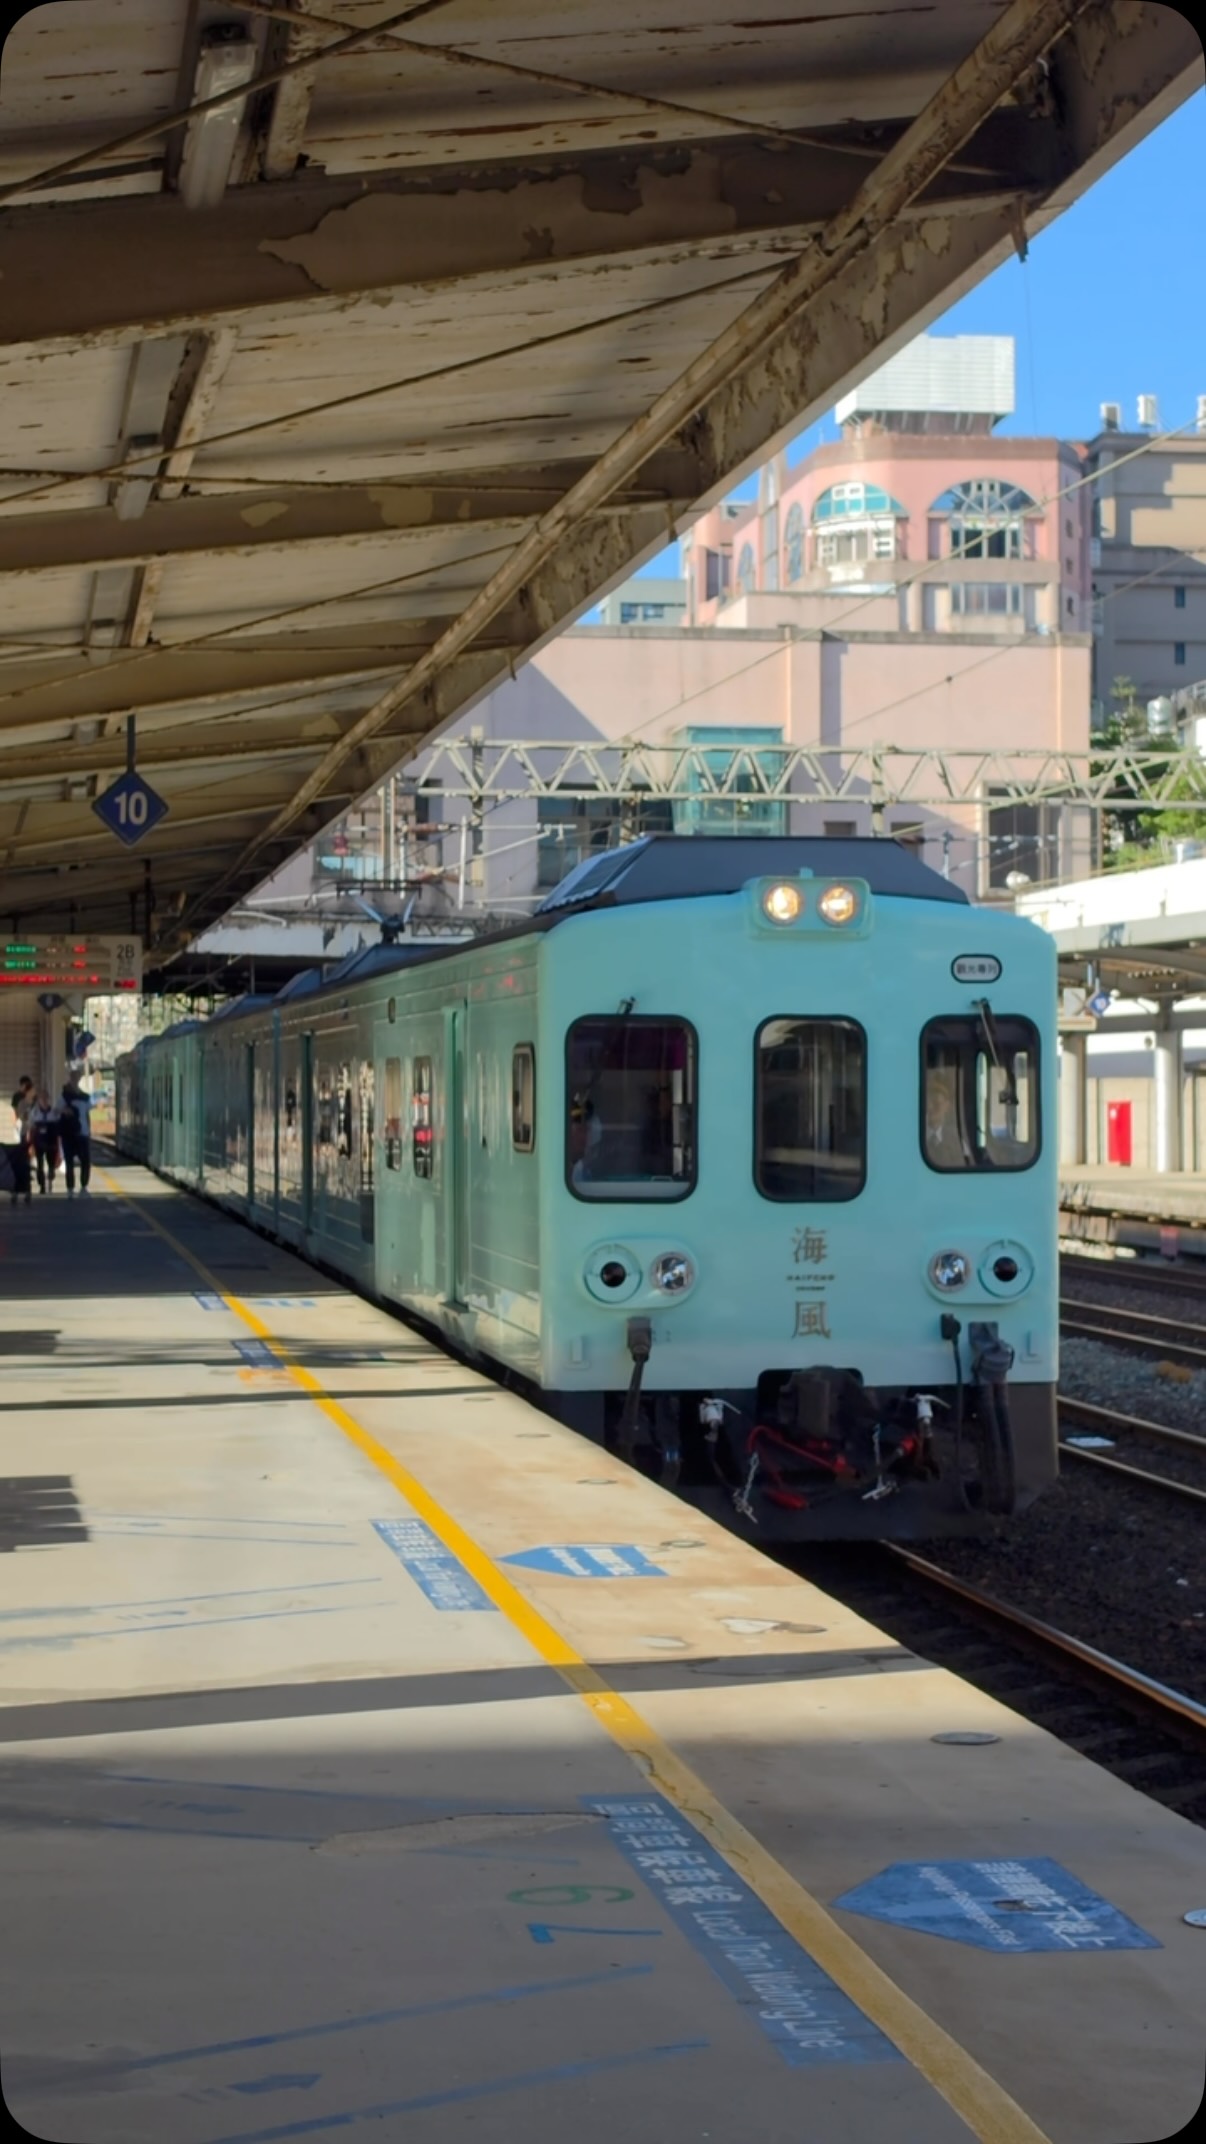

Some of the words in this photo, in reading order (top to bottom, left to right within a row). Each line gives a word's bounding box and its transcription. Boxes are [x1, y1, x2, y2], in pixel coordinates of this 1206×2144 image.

[114, 792, 148, 825] 10
[116, 943, 135, 959] 2B
[792, 1226, 828, 1264] 海
[791, 1301, 831, 1339] 風
[692, 1910, 763, 1939] Local
[720, 1942, 782, 1970] Train
[743, 1971, 817, 2019] Waiting
[782, 2020, 846, 2048] Line
